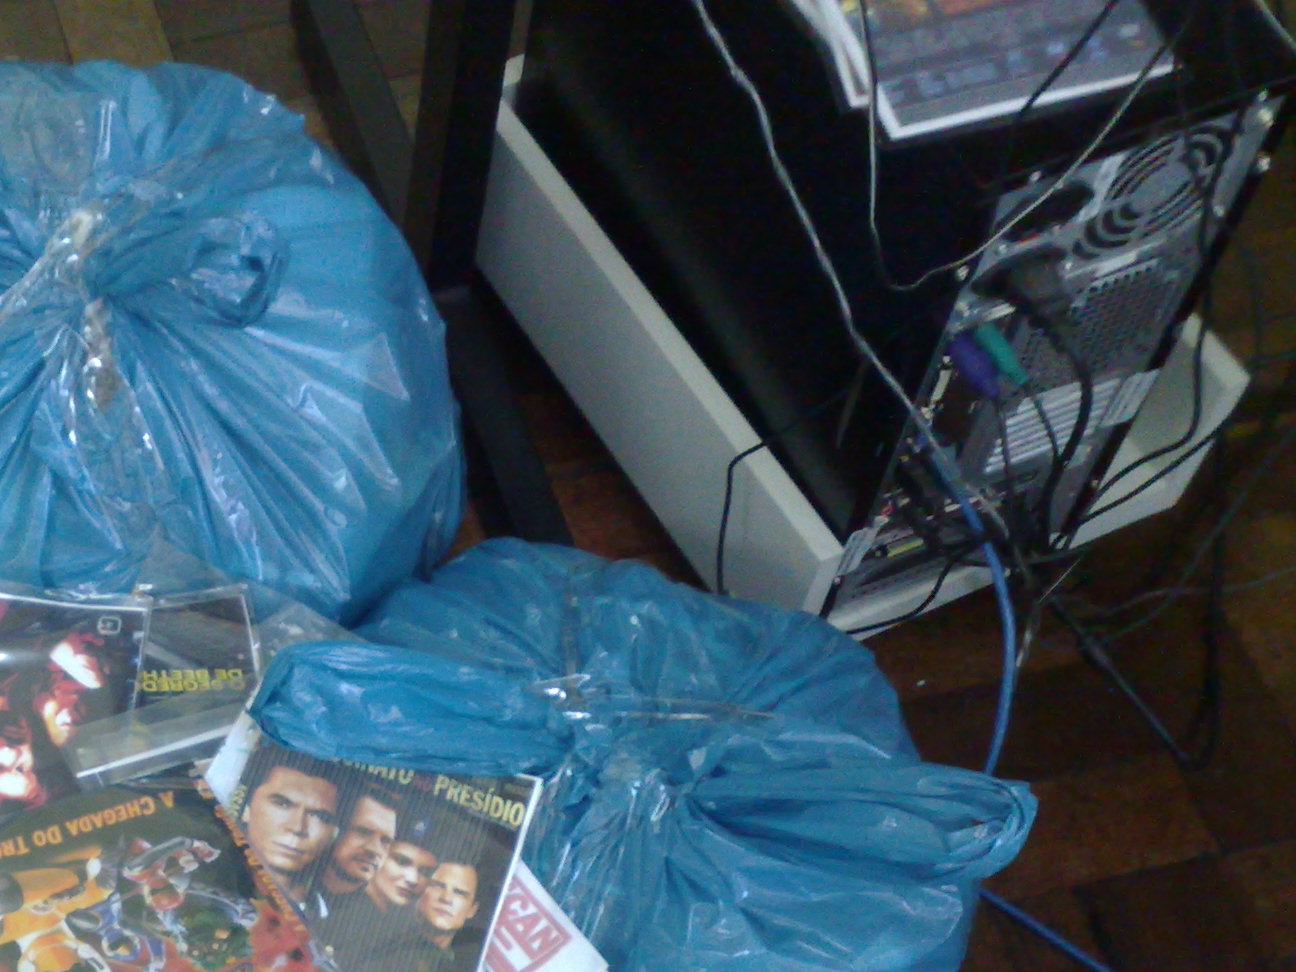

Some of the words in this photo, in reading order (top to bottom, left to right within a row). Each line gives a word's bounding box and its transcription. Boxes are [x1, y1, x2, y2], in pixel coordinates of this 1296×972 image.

[158, 790, 175, 809] A
[431, 773, 527, 828] PRESÍDIO
[64, 795, 155, 837] CHEGADA
[32, 825, 64, 848] DO
